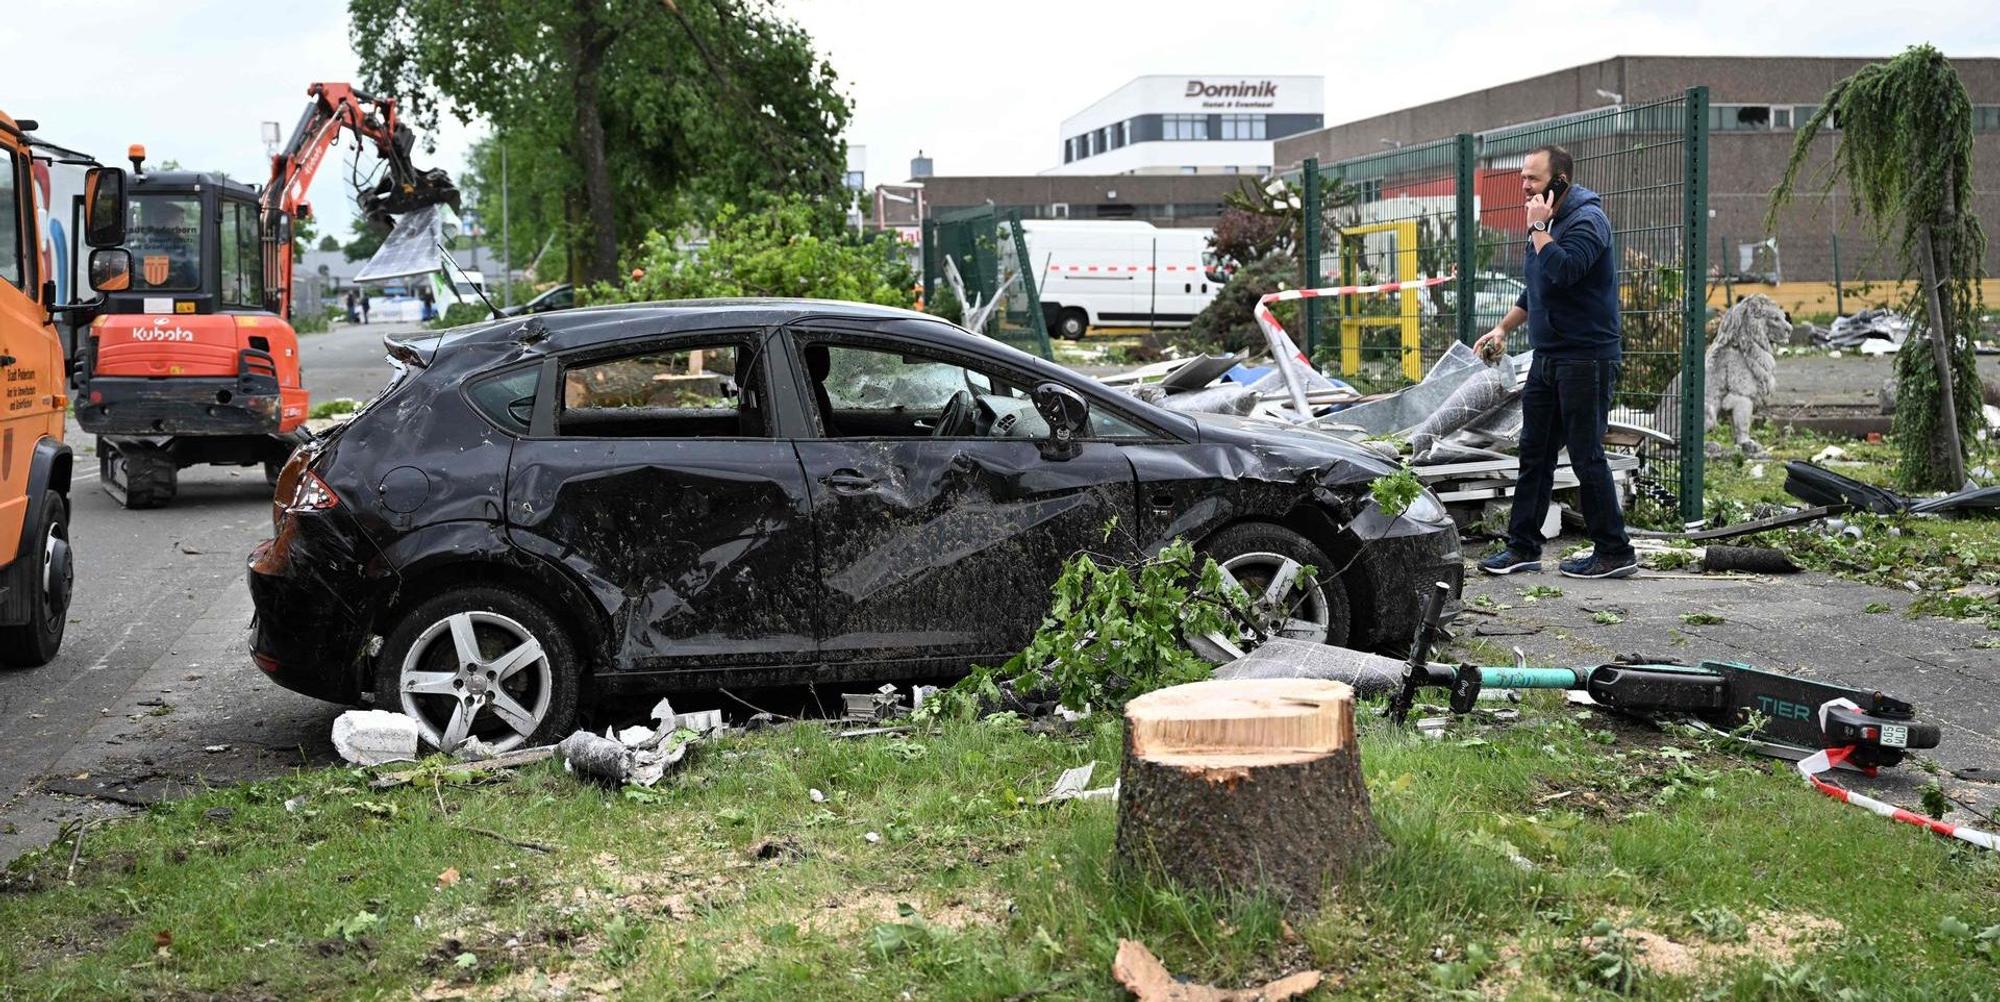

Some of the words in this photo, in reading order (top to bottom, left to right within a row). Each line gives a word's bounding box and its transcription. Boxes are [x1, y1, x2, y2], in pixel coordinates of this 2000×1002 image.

[1185, 80, 1278, 97] Dominik
[132, 327, 194, 342] Kubota
[1757, 695, 1811, 722] TIER
[1882, 726, 1894, 743] 605
